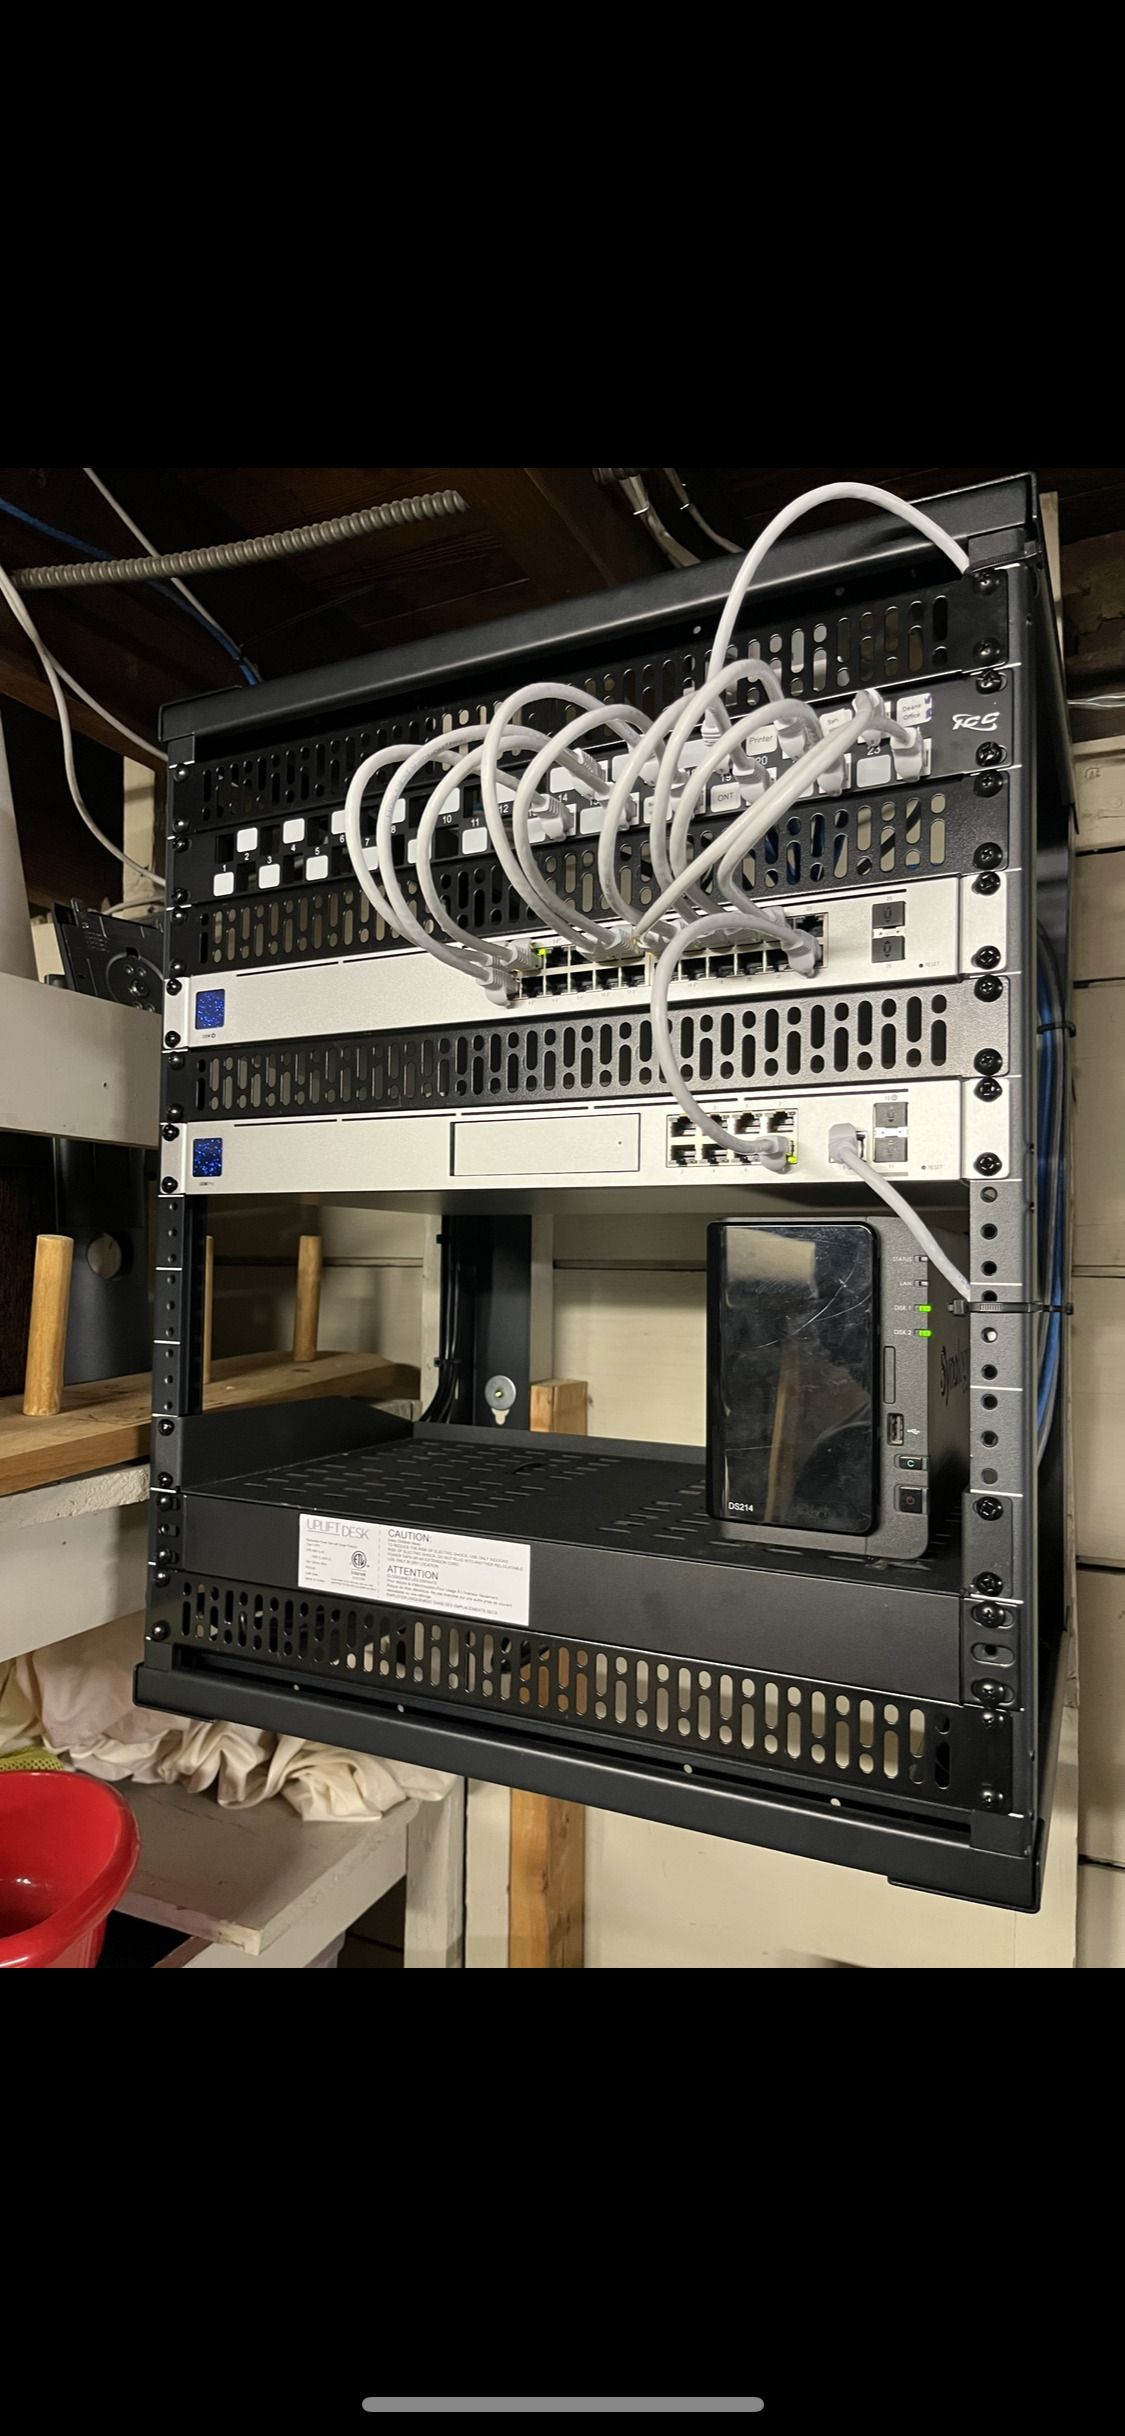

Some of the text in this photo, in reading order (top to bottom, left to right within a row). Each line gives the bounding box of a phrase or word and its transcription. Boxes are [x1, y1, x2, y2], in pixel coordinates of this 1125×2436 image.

[749, 735, 773, 744] Printer
[867, 745, 881, 756] 23
[558, 793, 568, 802] 14
[717, 792, 734, 801] ONT
[499, 804, 509, 814] 12
[442, 815, 452, 824] 10
[471, 818, 480, 827] 11
[391, 825, 396, 834] 8
[339, 835, 345, 843] 6
[364, 837, 370, 846] 7
[290, 844, 296, 852] 4
[314, 847, 320, 855] 5
[244, 853, 250, 861] 2
[267, 856, 273, 864] 3
[728, 1501, 754, 1513] DS214
[306, 1518, 369, 1540] UPLIFT DESK
[387, 1564, 439, 1580] ATTENTION
